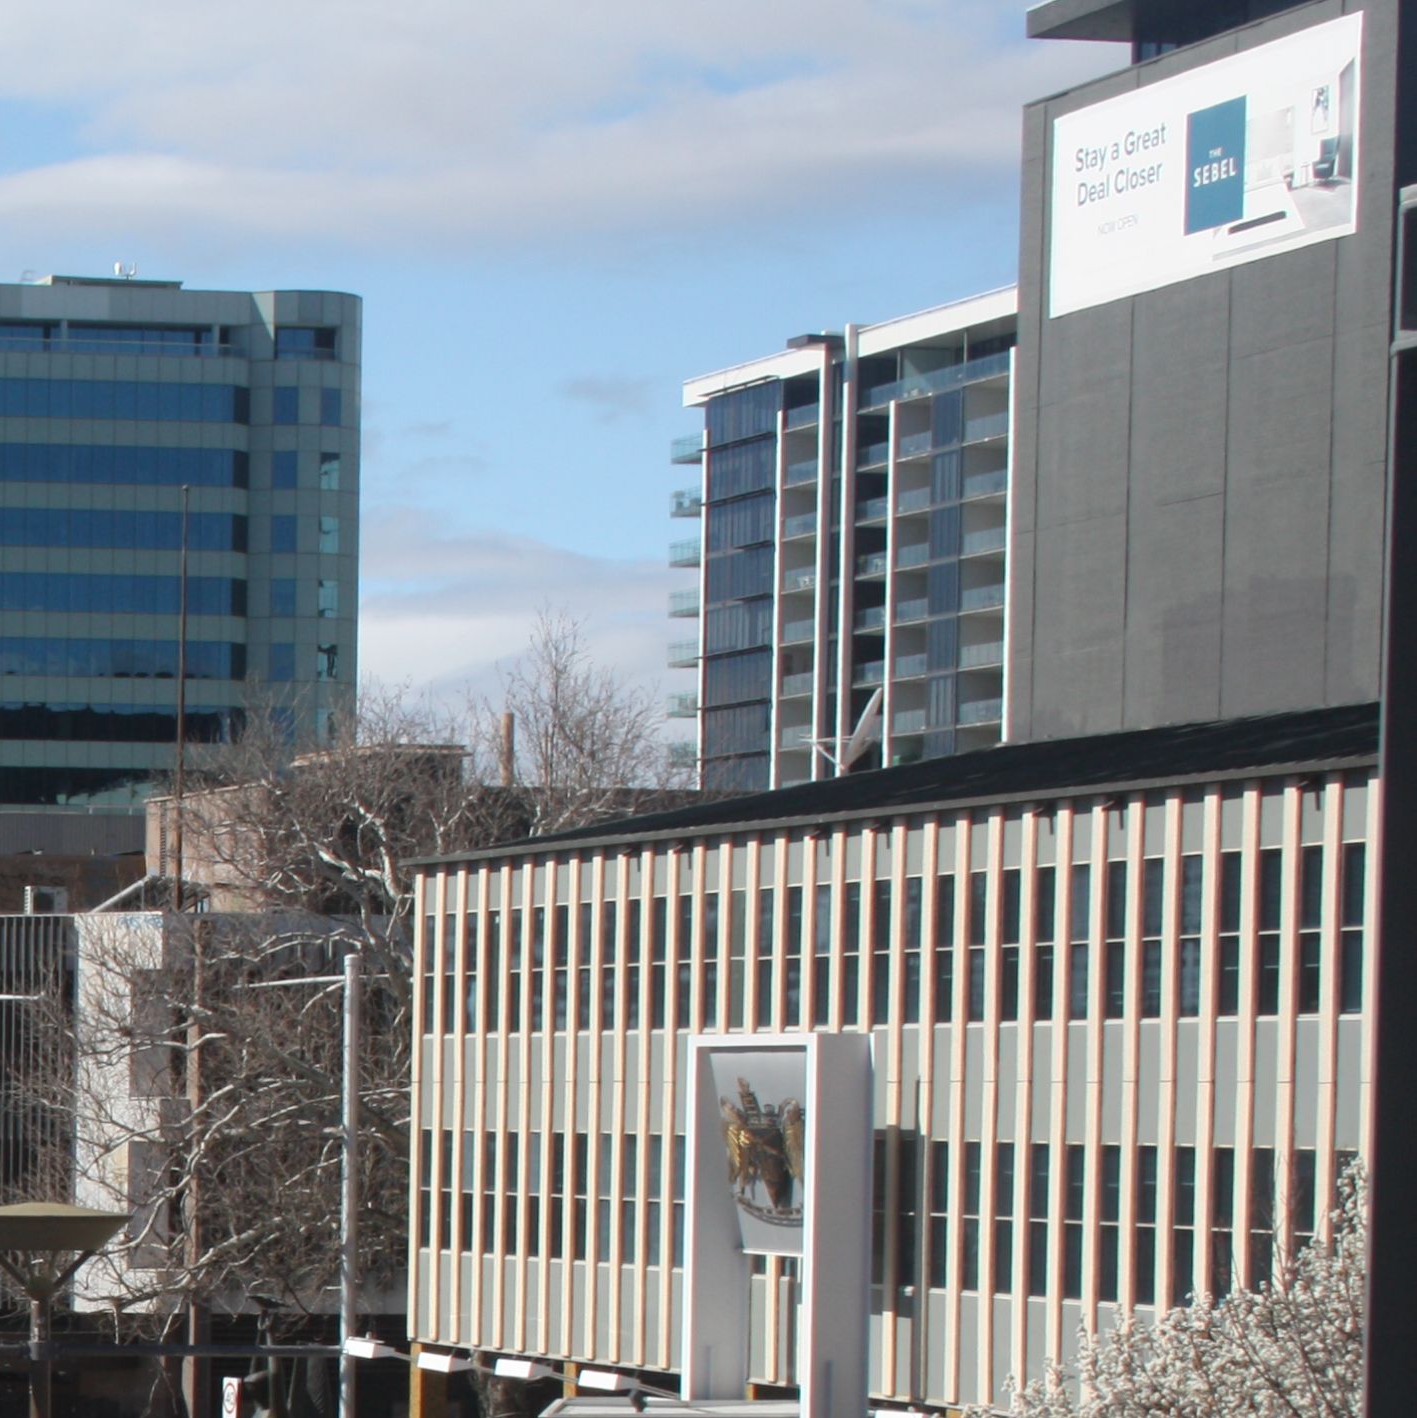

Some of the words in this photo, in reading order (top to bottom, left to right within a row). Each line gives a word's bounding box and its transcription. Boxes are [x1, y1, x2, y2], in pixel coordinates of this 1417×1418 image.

[1075, 146, 1107, 172] Stay
[1111, 142, 1119, 160] a
[1124, 123, 1166, 156] Great
[1209, 147, 1222, 159] THE
[1077, 175, 1110, 206] Deal
[1114, 163, 1163, 194] Closer
[1193, 157, 1237, 188] SEBEL
